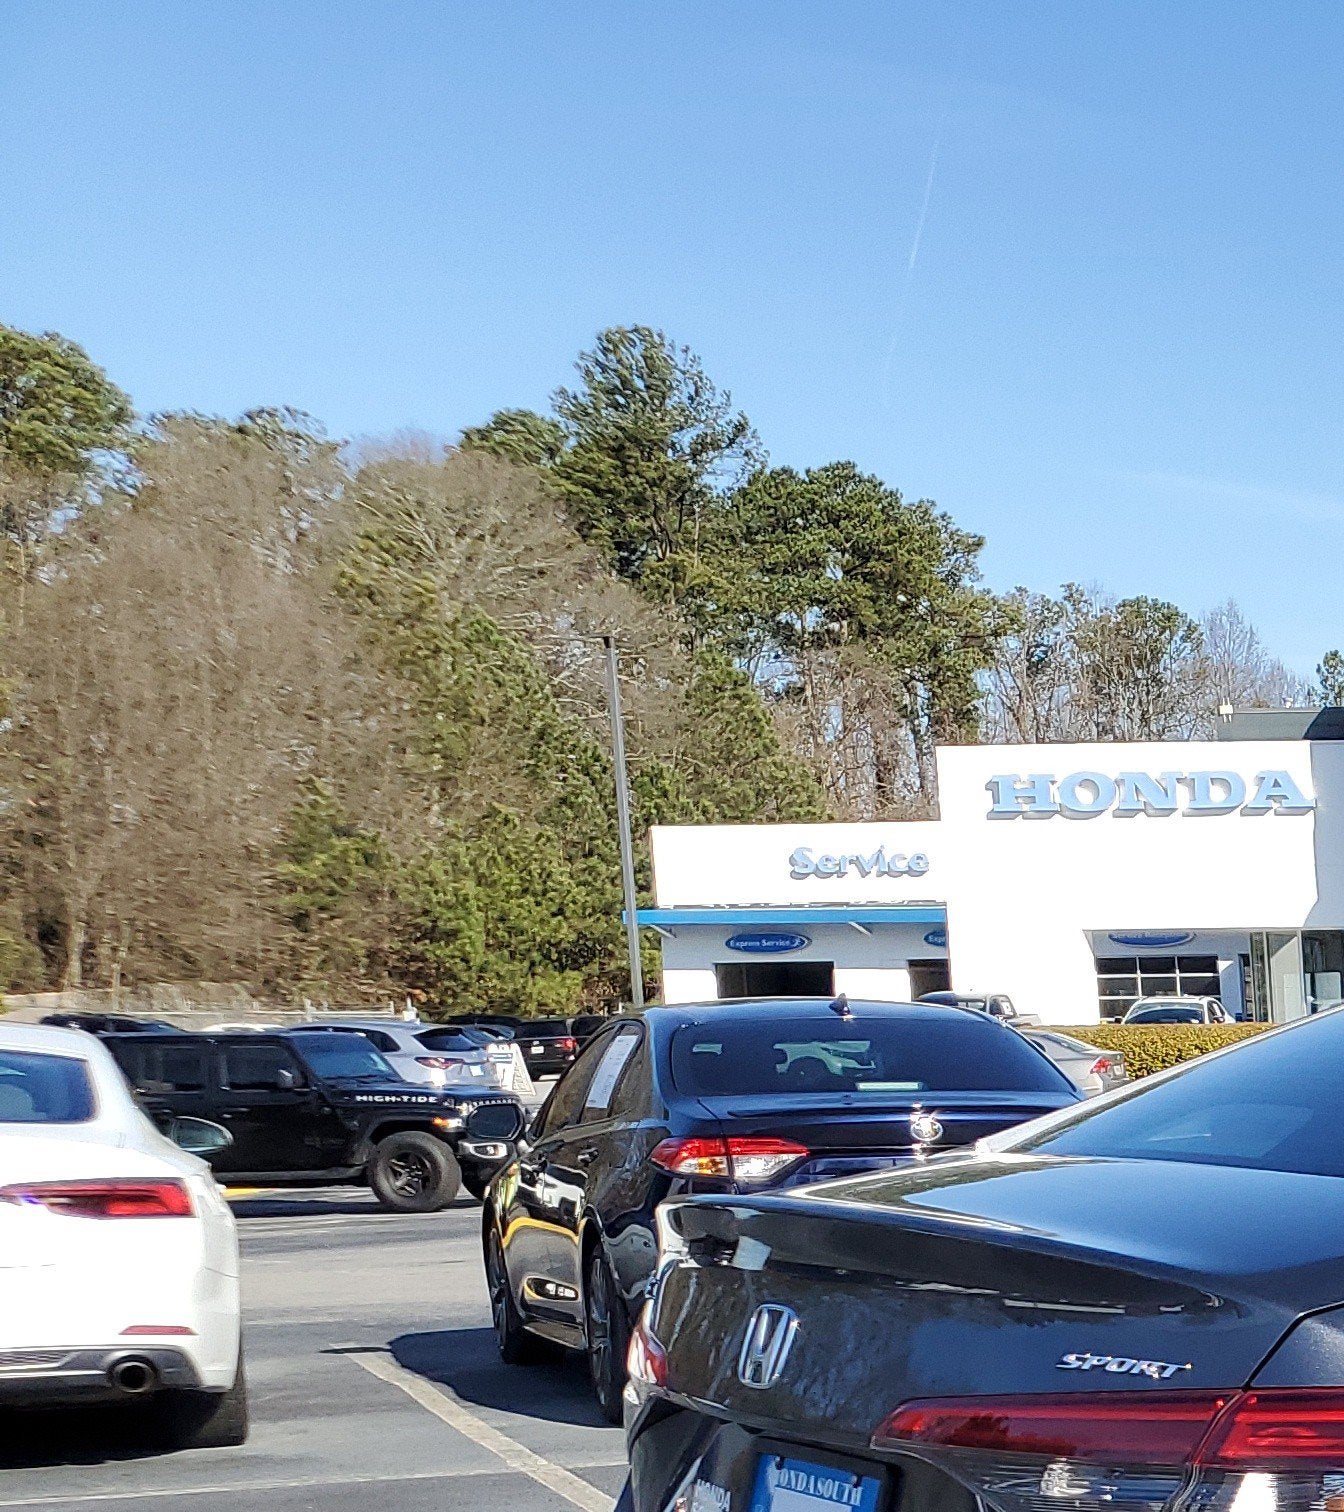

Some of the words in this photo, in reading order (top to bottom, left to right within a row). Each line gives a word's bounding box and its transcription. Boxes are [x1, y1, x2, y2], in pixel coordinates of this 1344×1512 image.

[986, 770, 1316, 819] HONDA
[789, 845, 930, 880] Service
[1056, 1353, 1192, 1379] SPORT
